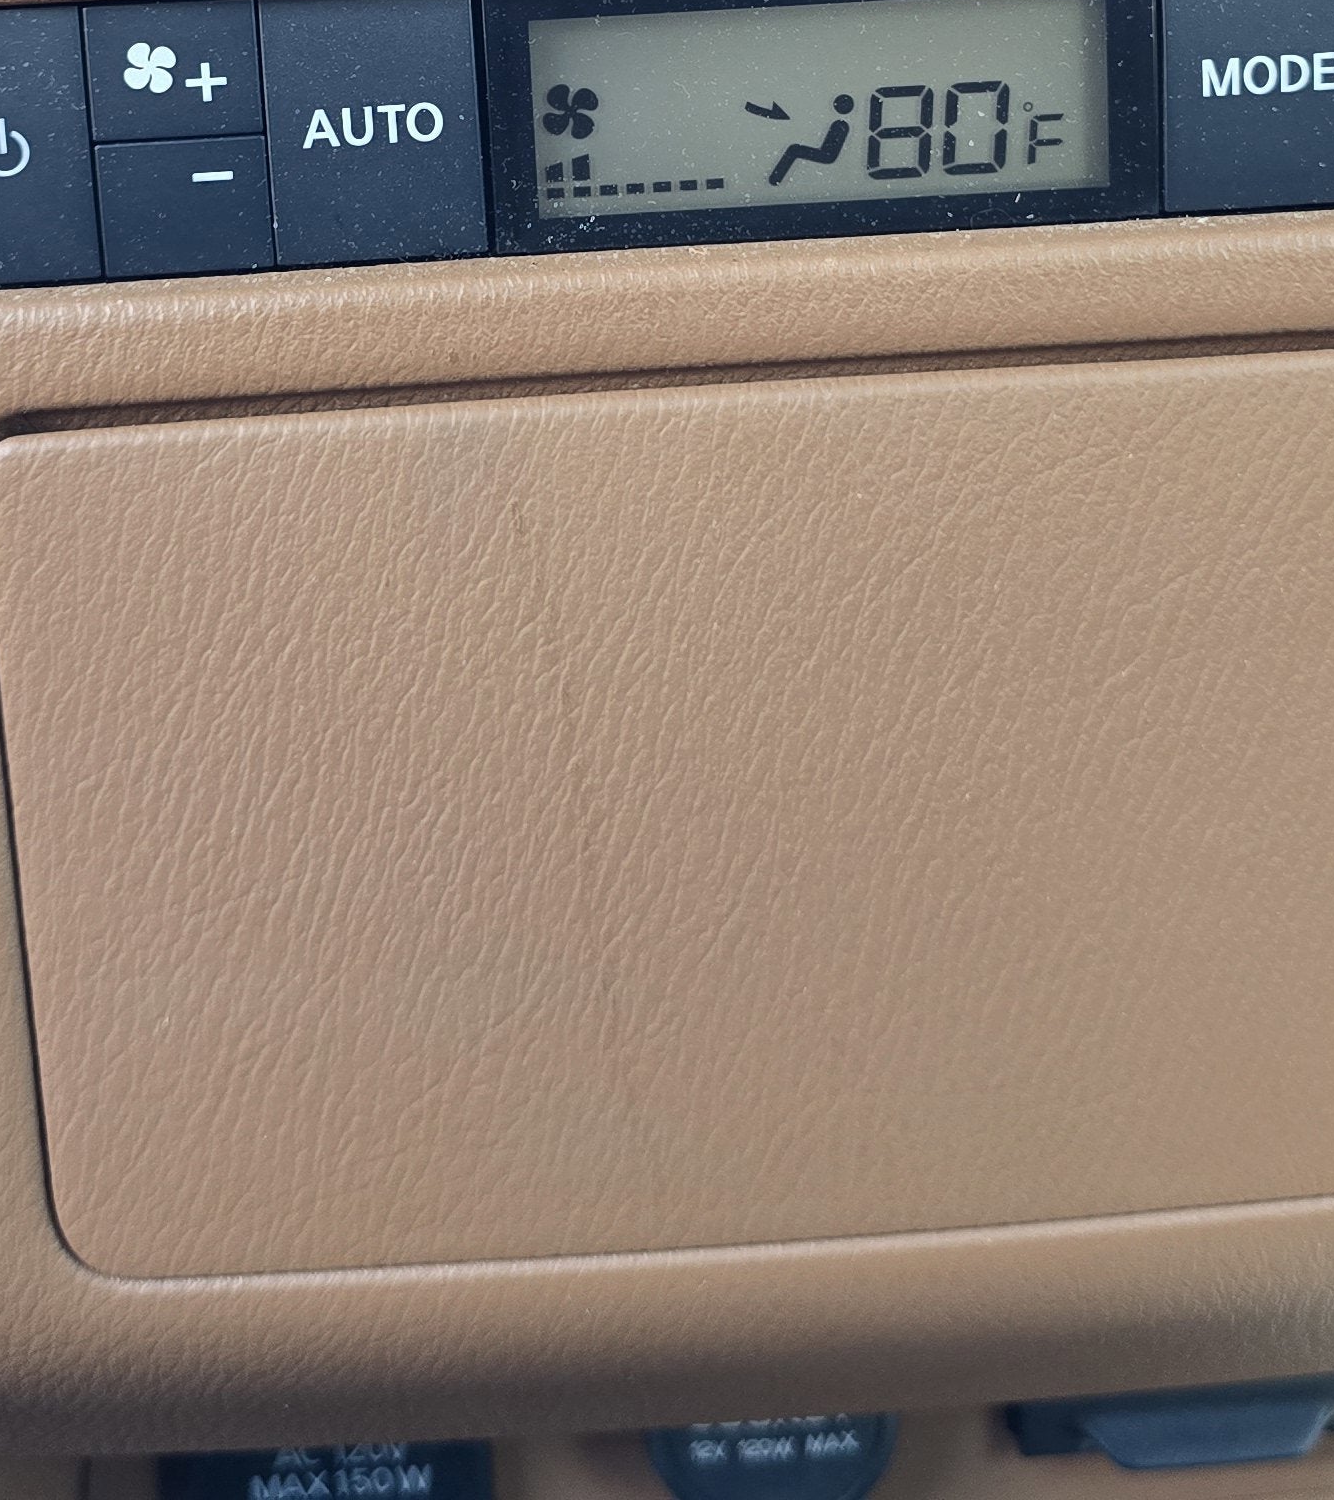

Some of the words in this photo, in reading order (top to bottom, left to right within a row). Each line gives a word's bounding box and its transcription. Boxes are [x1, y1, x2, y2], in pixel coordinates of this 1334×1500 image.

[302, 102, 444, 149] AUTO
[805, 1429, 861, 1457] MAX
[247, 1470, 331, 1500] MAX
